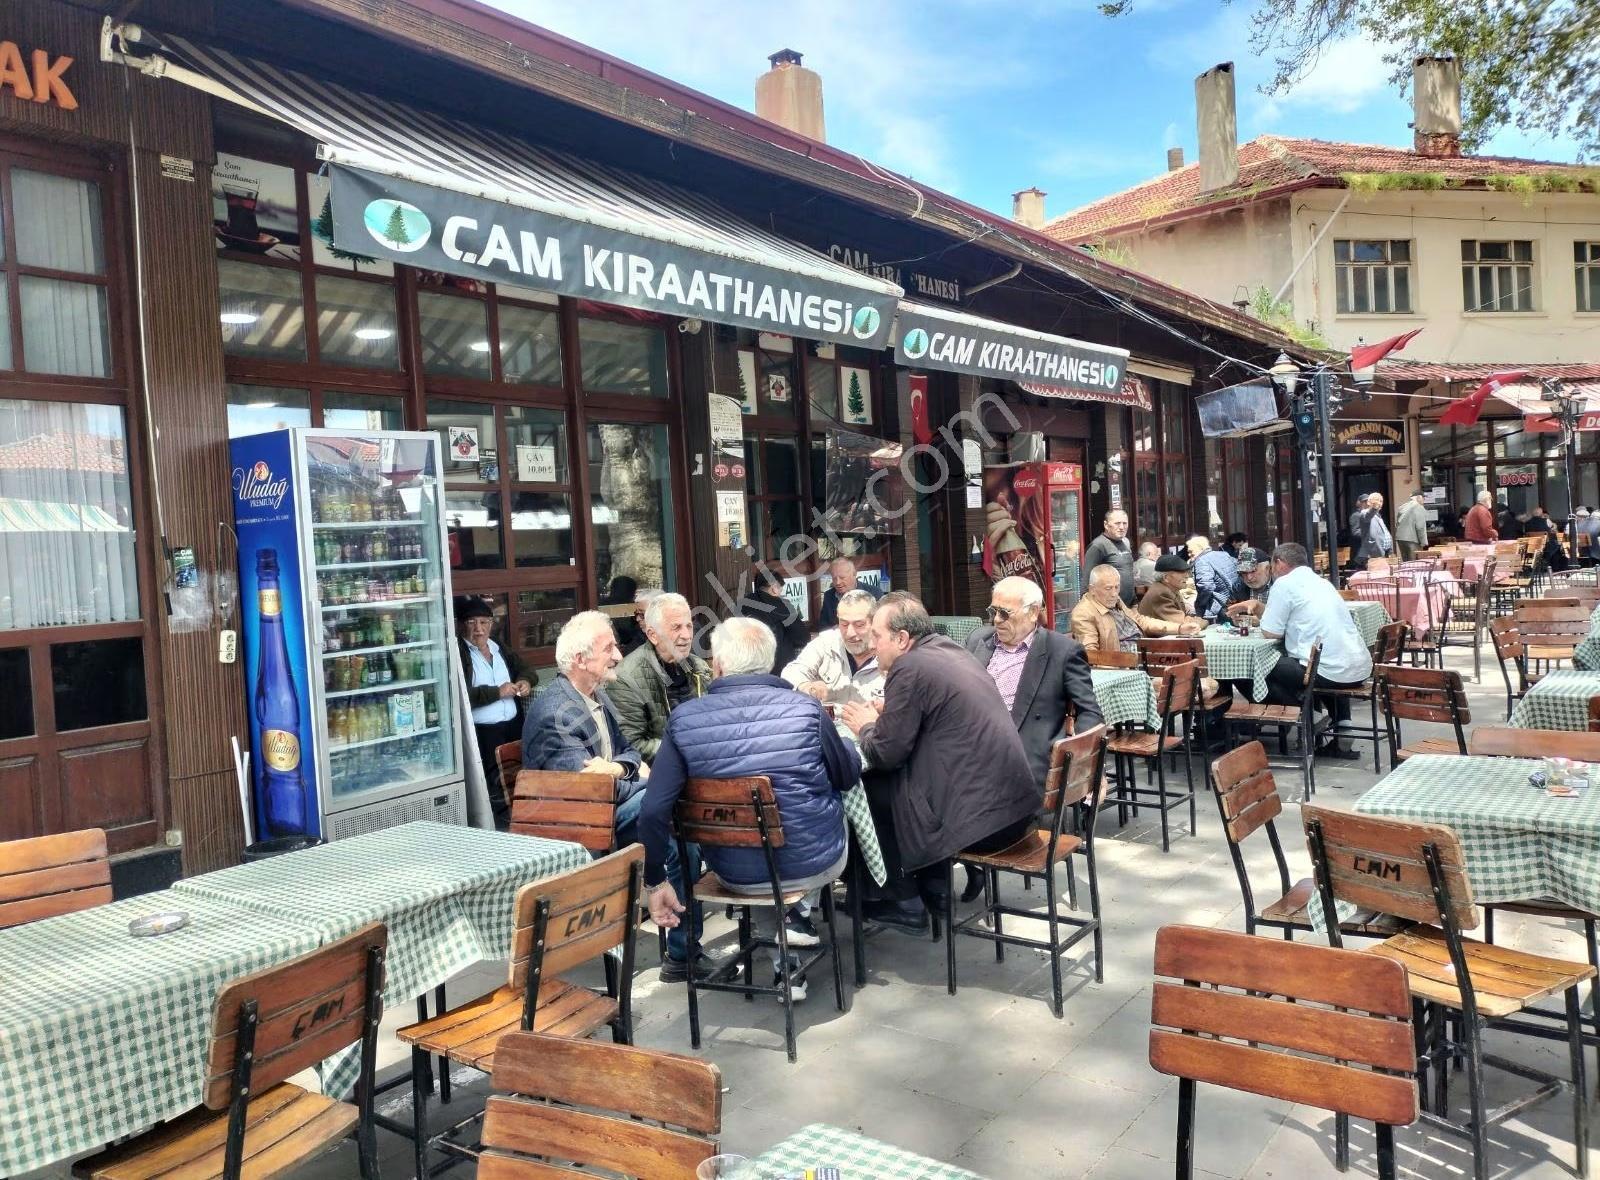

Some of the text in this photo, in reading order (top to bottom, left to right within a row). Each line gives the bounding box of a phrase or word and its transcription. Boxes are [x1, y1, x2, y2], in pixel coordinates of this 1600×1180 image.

[441, 215, 853, 334] ÇAM KIRAATHANESİ
[978, 341, 1105, 386] KIRAATHANESİ
[232, 467, 289, 509] Uludağ
[1500, 472, 1537, 485] DOST
[785, 581, 803, 598] AM
